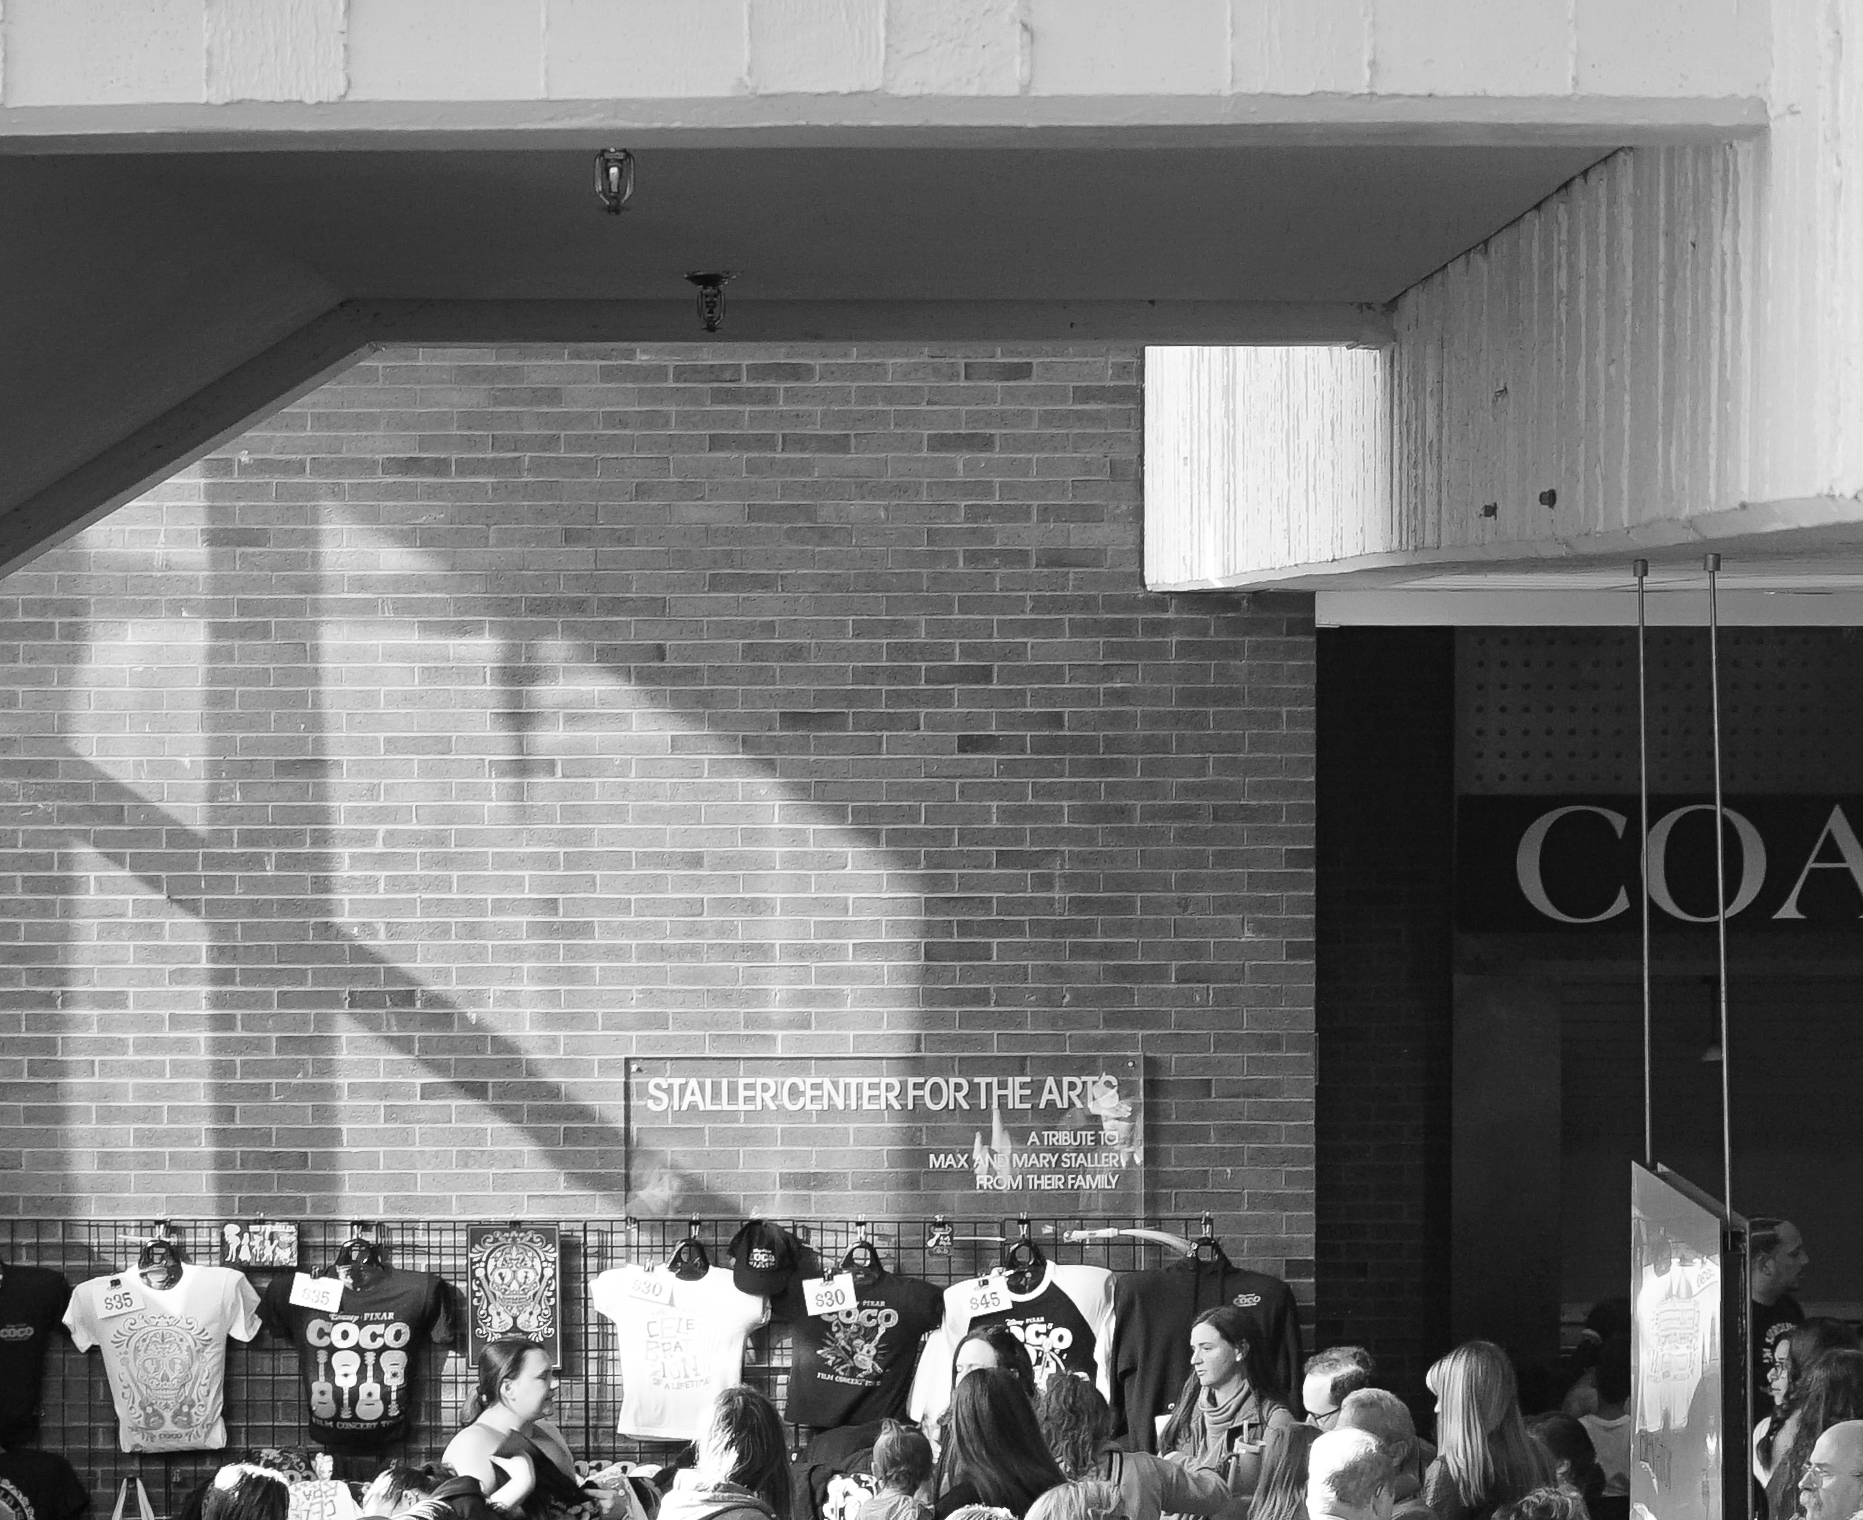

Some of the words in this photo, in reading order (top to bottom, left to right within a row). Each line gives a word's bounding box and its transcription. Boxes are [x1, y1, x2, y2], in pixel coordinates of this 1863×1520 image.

[646, 1076, 777, 1112] STALLER
[782, 1076, 901, 1111] CENTER
[907, 1076, 969, 1111] FOR
[974, 1076, 1032, 1110] THE
[1040, 1075, 1119, 1109] ARTS
[1028, 1131, 1040, 1146] A
[1042, 1130, 1096, 1146] TRIBUTE
[1099, 1130, 1119, 1146] TO
[929, 1154, 969, 1169] MAX
[972, 1154, 1009, 1169] AND
[1012, 1153, 1059, 1169] MARY
[1061, 1153, 1119, 1168] STALLER
[976, 1175, 1023, 1190] FROM
[1026, 1175, 1065, 1190] THEIR
[1067, 1174, 1119, 1190] FAMILY
[301, 1286, 331, 1306] $35
[632, 1279, 663, 1297] $30
[103, 1291, 133, 1310] $35
[815, 1288, 846, 1308] $30
[969, 1291, 1001, 1311] $45
[363, 1312, 395, 1321] PIXAR
[305, 1318, 411, 1350] COCO
